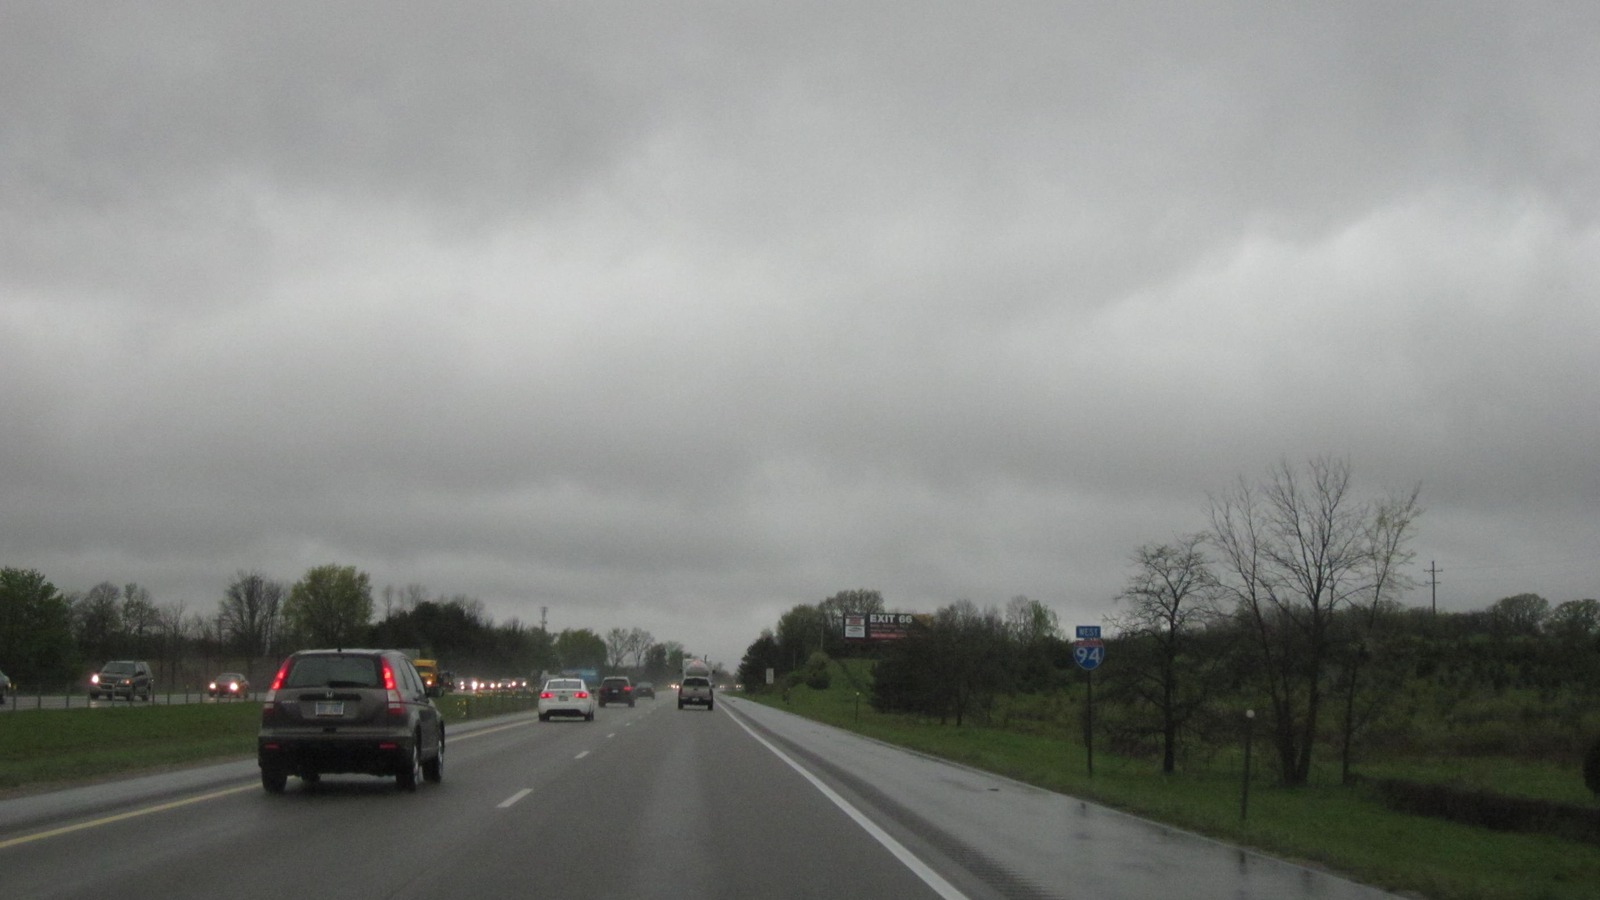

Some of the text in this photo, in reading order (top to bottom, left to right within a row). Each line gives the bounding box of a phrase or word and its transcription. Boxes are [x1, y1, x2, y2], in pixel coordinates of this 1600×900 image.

[869, 614, 896, 623] EXIT
[898, 614, 913, 624] 66
[1078, 627, 1098, 637] WEST
[1076, 647, 1100, 664] 94
